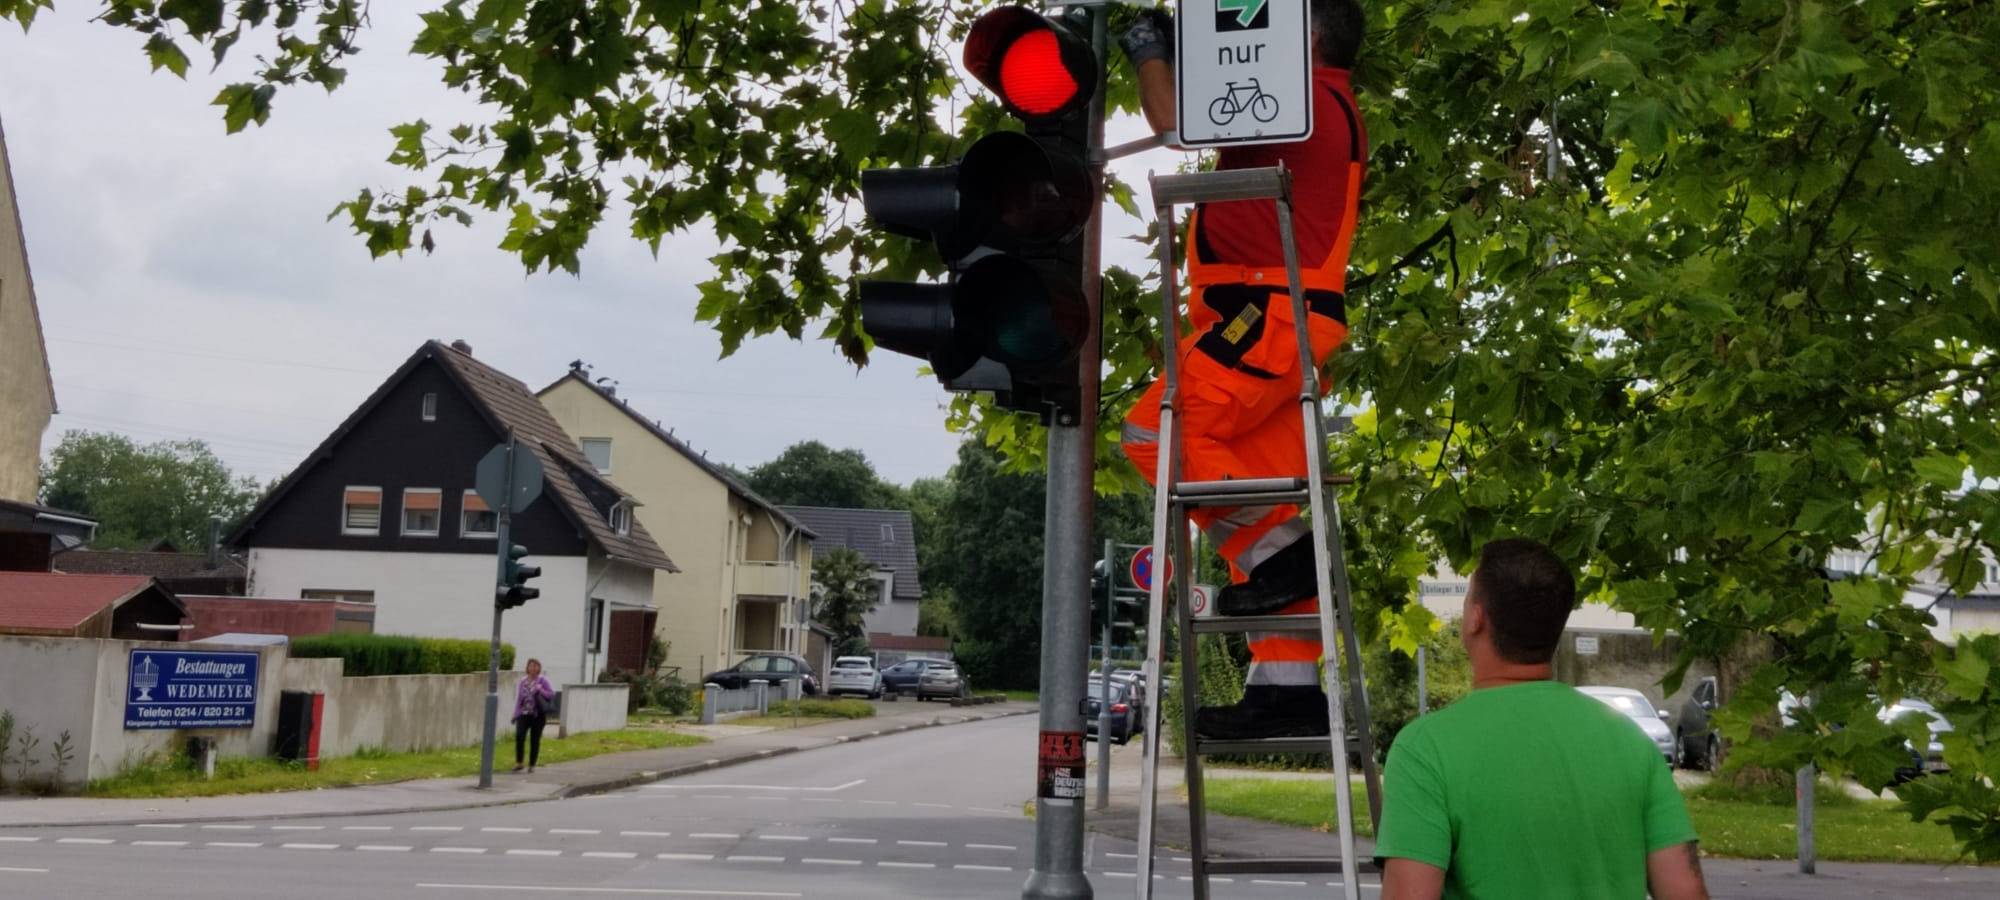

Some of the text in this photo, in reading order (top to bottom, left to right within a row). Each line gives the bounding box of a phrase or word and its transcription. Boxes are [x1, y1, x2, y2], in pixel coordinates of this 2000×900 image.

[1218, 43, 1266, 65] nur
[175, 658, 246, 678] Bestattungen
[167, 684, 253, 698] WEDEMEYER
[138, 707, 172, 717] Telefon
[174, 707, 196, 717] 0214
[204, 707, 221, 717] 820
[223, 707, 233, 716] 21
[235, 707, 245, 716] 21
